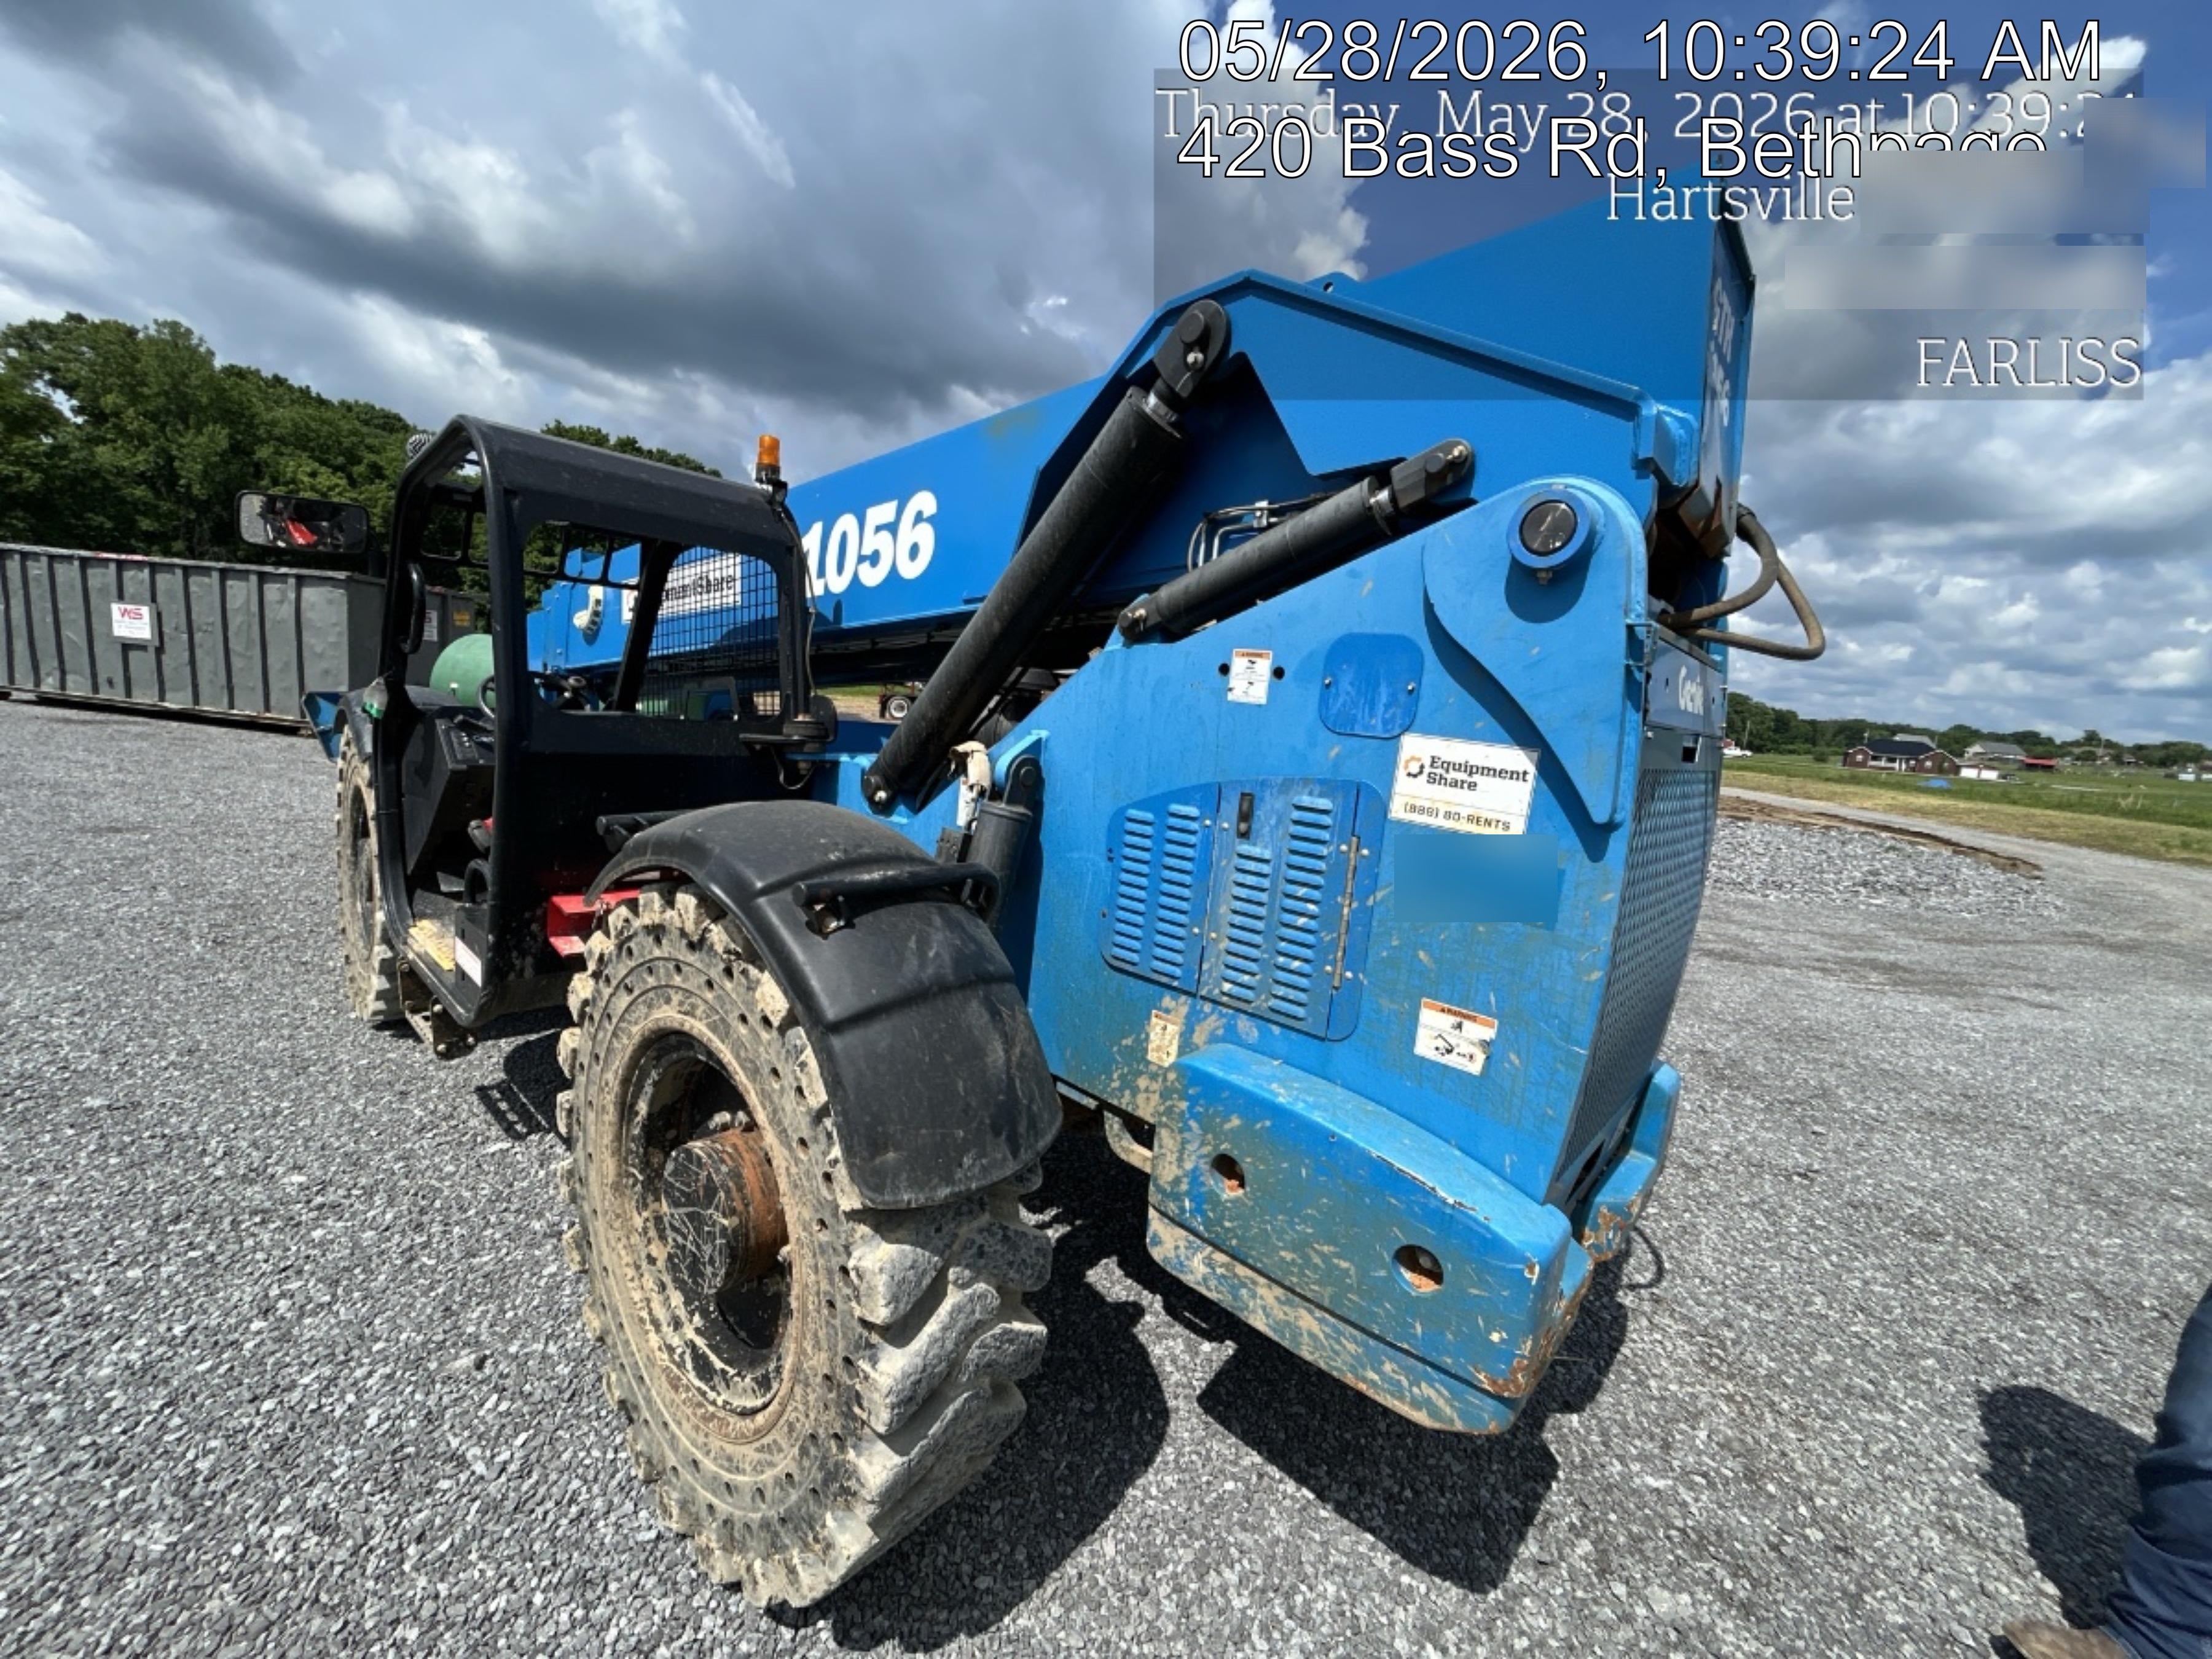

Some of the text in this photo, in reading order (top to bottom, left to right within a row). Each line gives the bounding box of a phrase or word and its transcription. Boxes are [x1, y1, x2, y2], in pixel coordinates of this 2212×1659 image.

[801, 490, 938, 598] 1056
[1426, 771, 1478, 791] Share
[1429, 755, 1531, 782] Equipment
